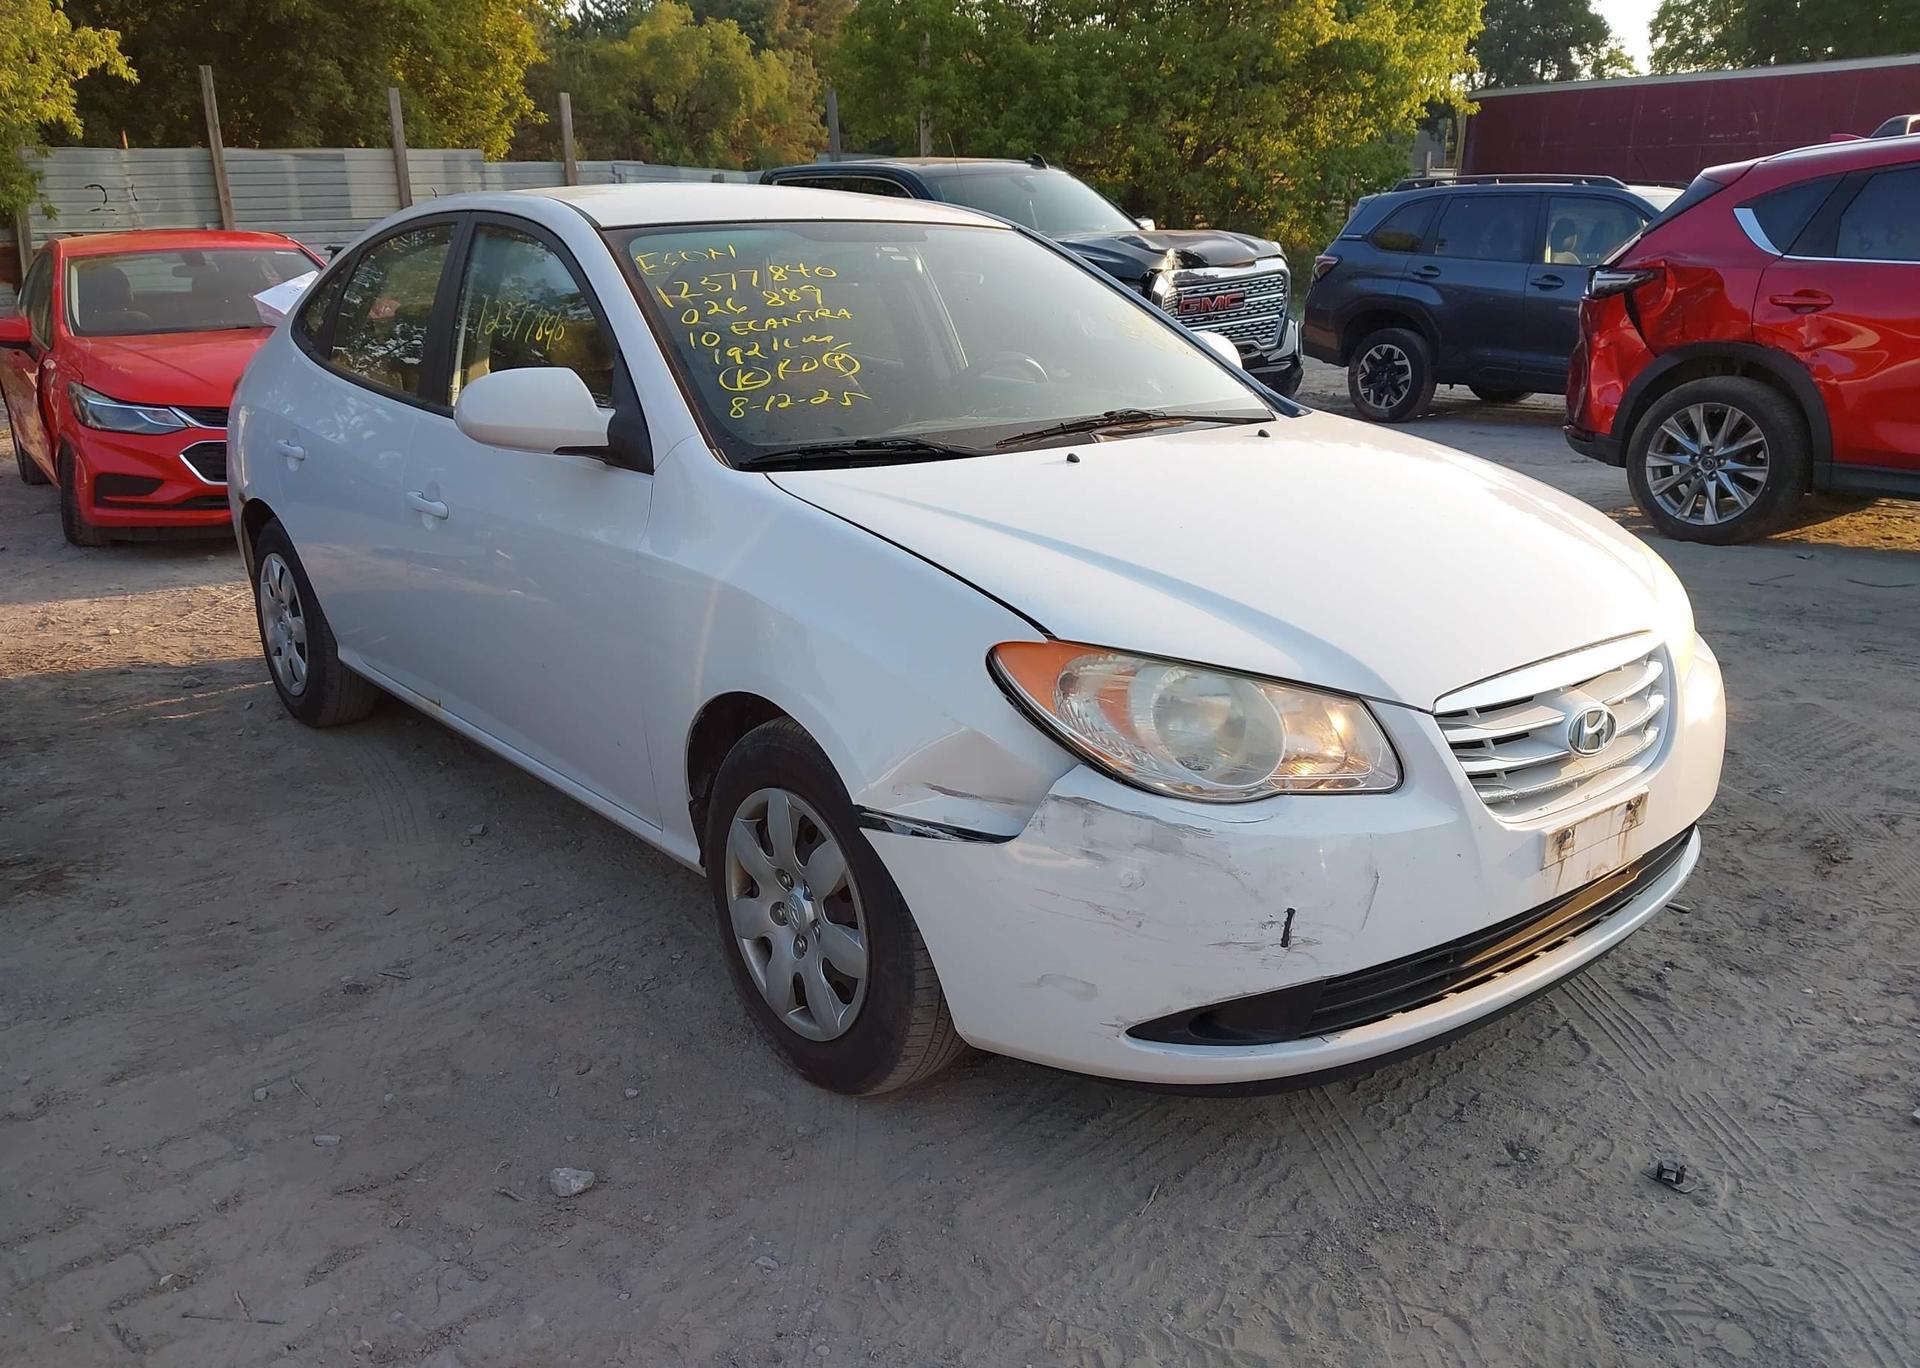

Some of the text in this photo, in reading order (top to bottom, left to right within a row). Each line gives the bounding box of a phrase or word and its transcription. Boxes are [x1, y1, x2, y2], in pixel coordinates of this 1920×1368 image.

[1179, 292, 1245, 315] GMC
[689, 331, 721, 350] 10
[714, 341, 769, 365] 192
[729, 388, 873, 419] 8-12-25
